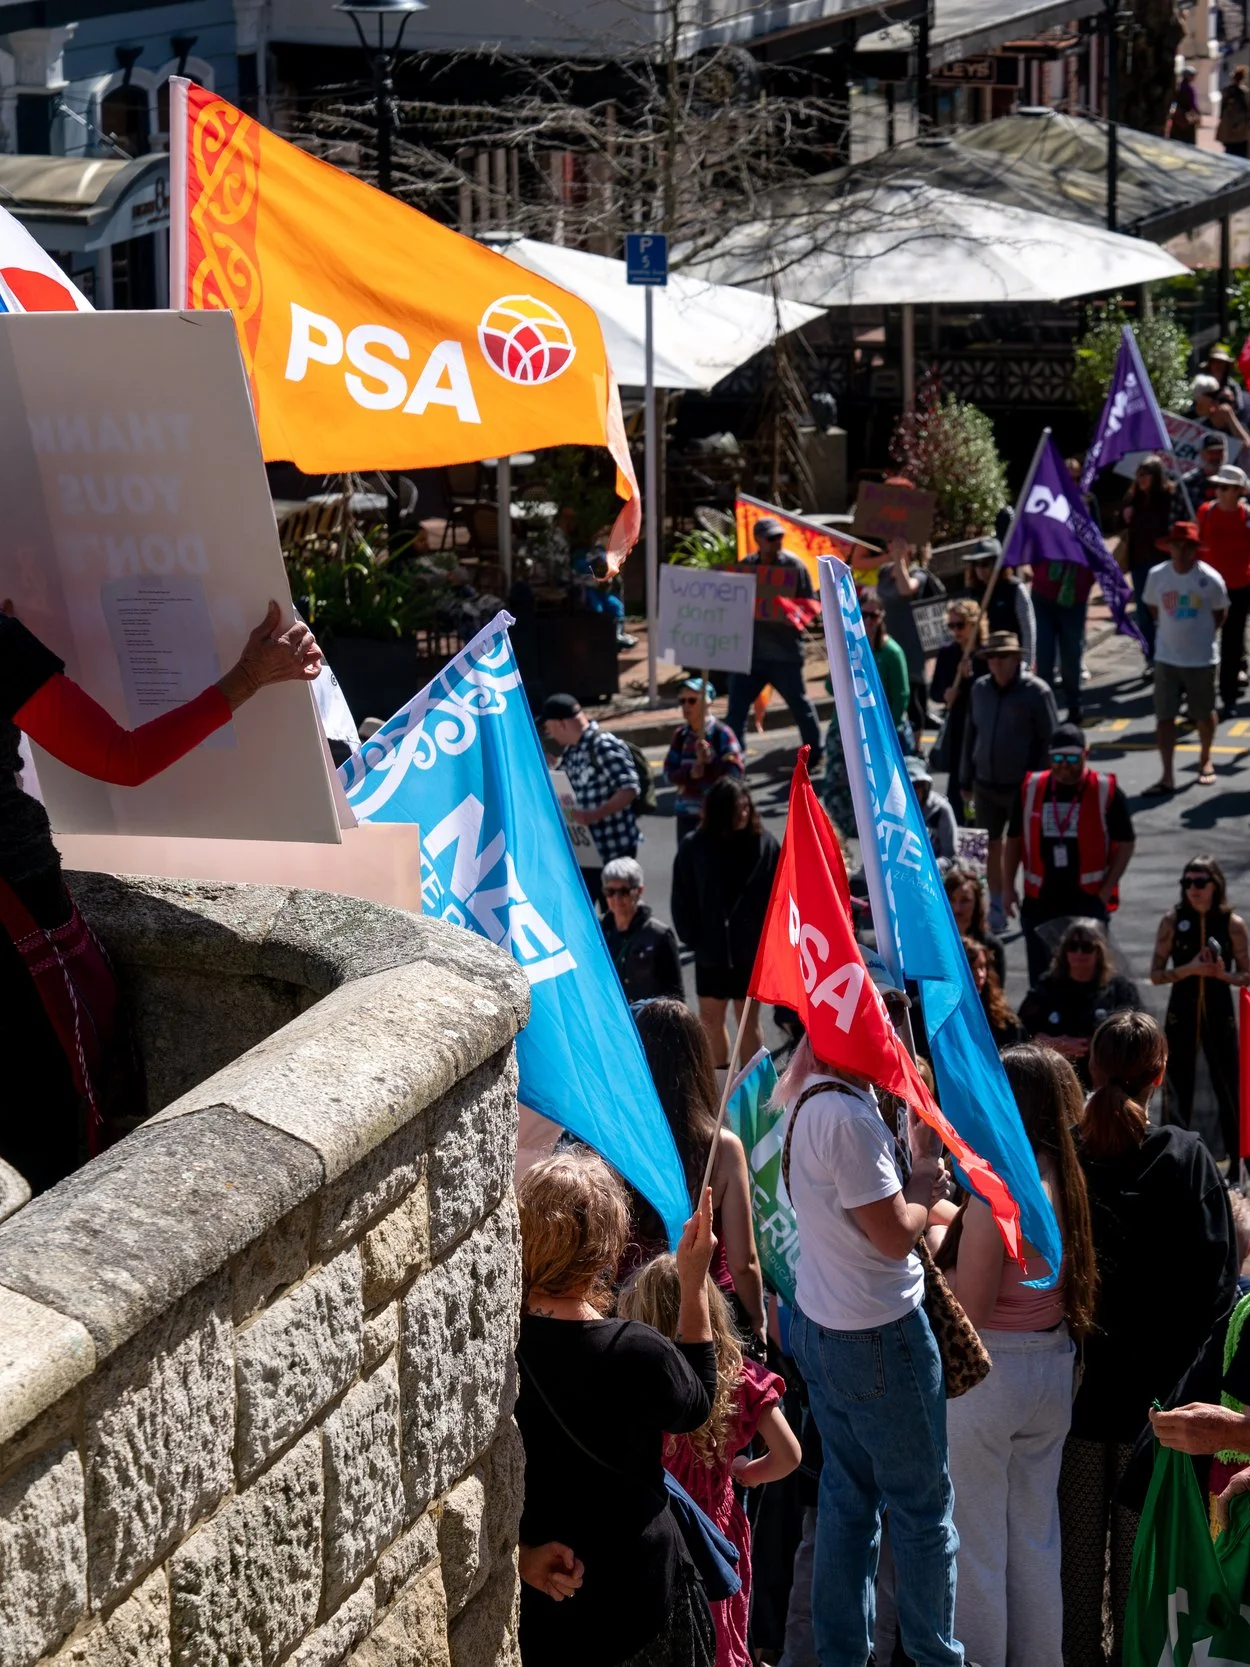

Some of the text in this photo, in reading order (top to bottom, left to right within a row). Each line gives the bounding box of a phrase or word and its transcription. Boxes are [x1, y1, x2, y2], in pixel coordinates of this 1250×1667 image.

[640, 237, 653, 254] P
[284, 301, 483, 424] PSA
[670, 578, 748, 604] women
[668, 622, 744, 658] forget
